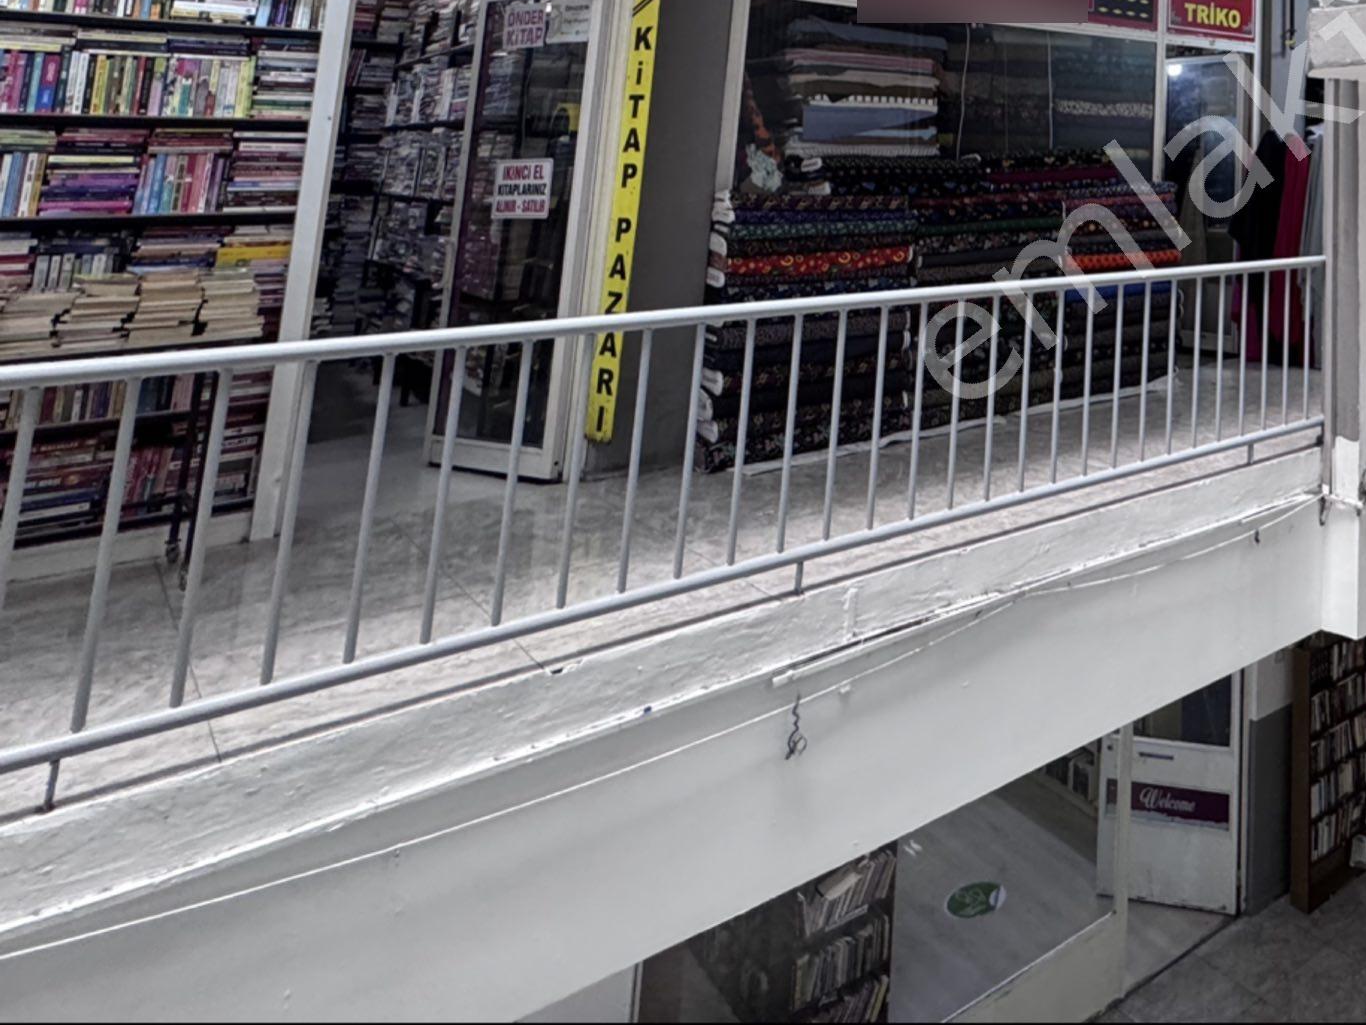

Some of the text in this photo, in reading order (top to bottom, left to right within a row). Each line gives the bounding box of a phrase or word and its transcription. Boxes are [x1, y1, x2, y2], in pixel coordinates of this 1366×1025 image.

[1184, 2, 1241, 28] TRİKO
[596, 217, 631, 432] PAZARI
[1140, 787, 1196, 812] Welcome
